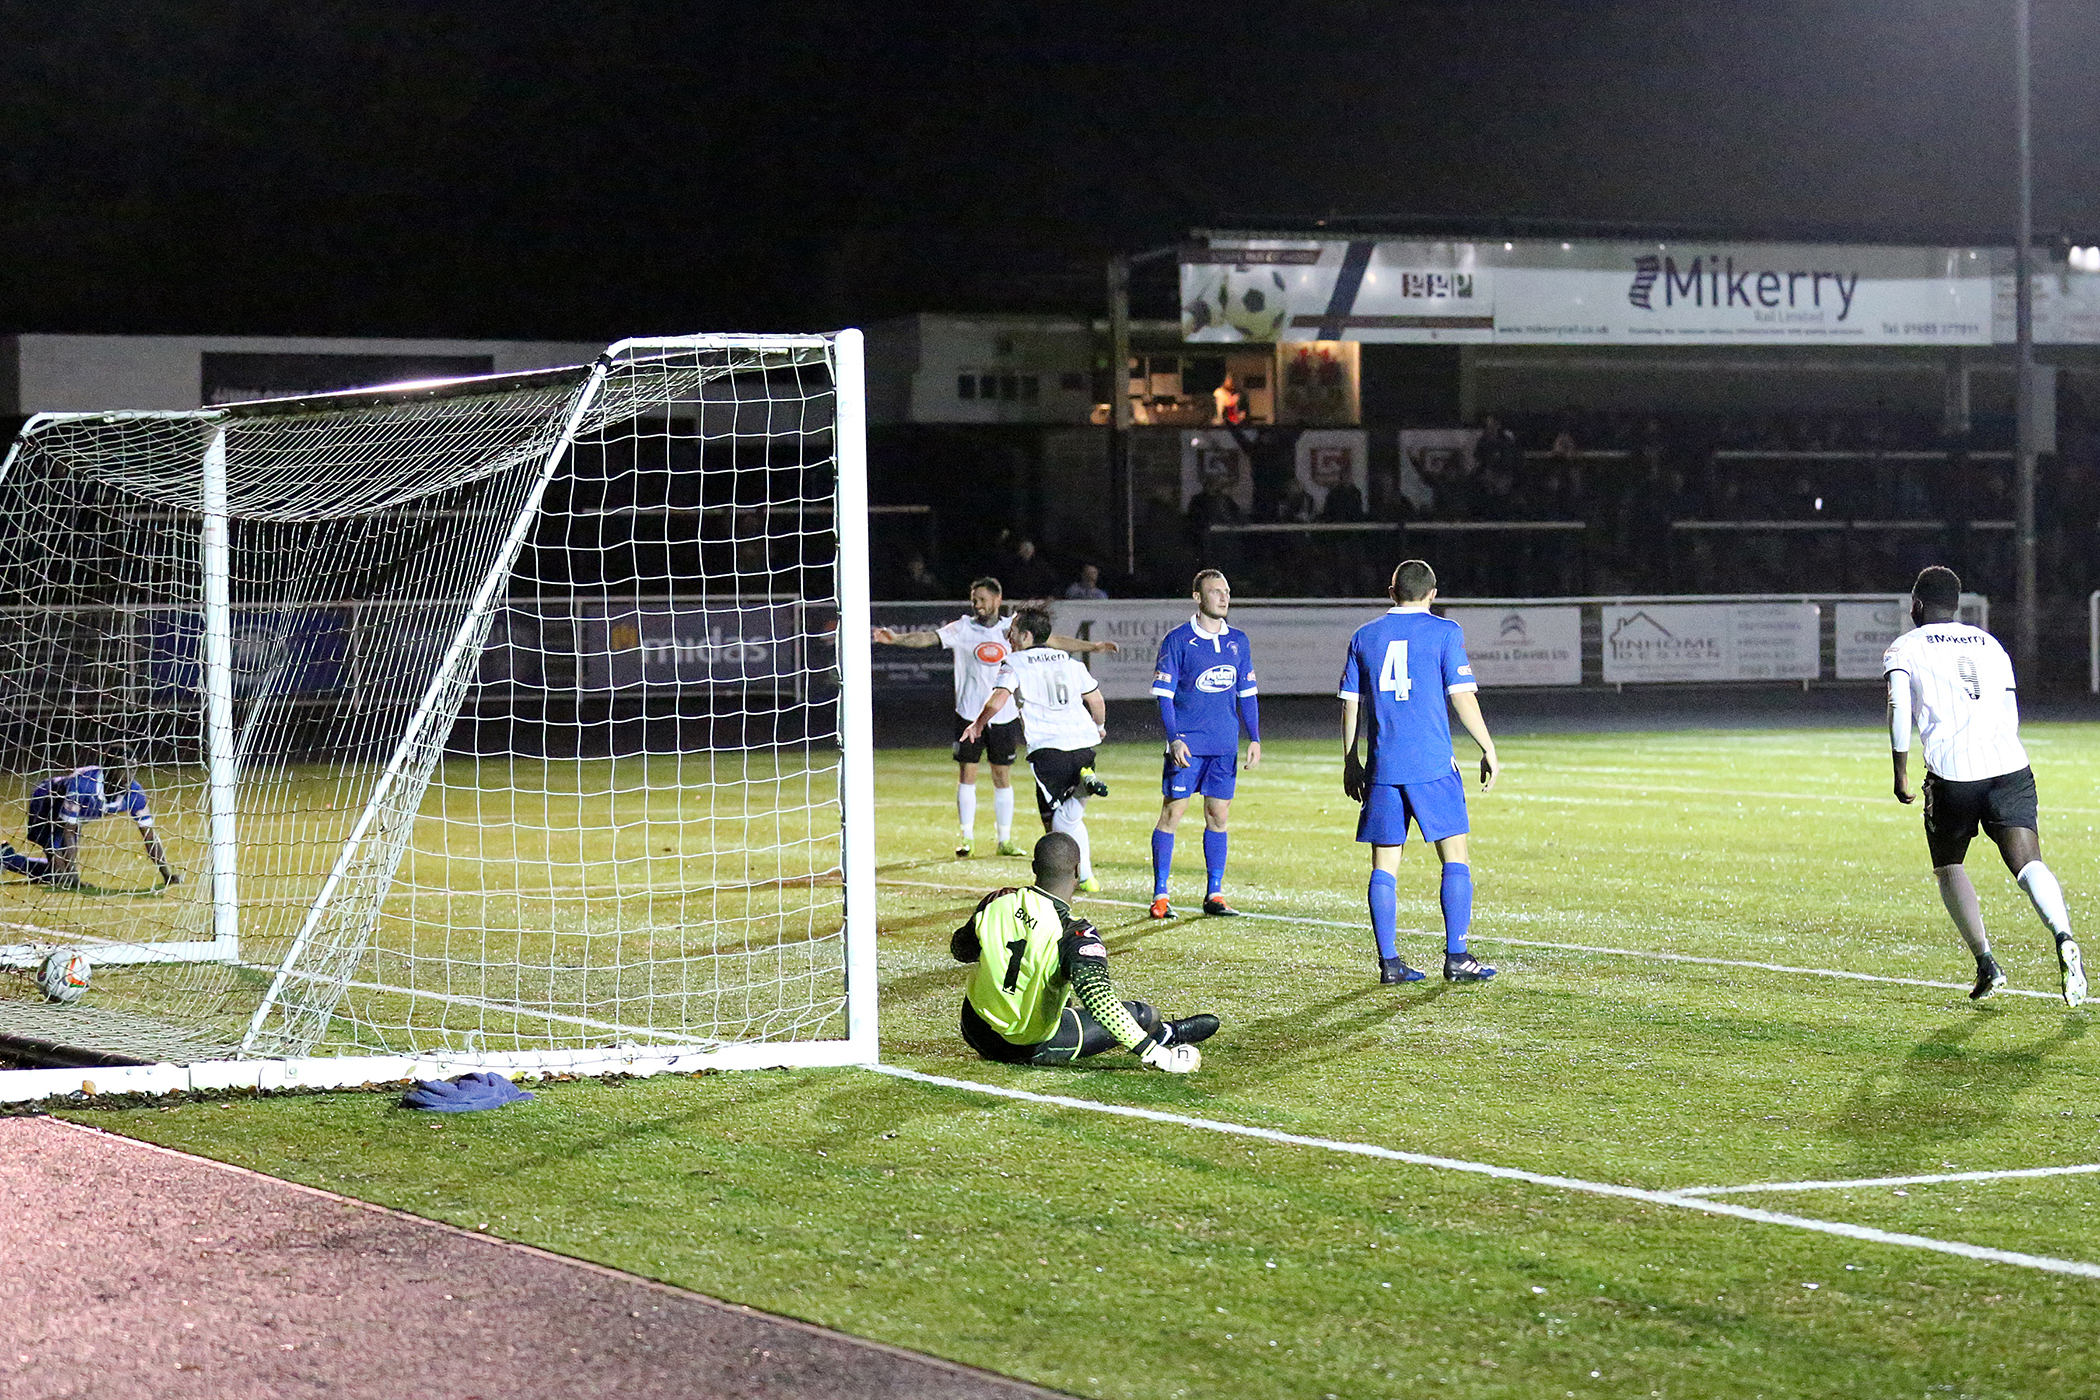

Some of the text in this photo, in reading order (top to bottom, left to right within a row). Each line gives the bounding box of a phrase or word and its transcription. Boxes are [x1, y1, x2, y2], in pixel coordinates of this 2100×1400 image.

[1665, 256, 1858, 321] Mikerry
[643, 627, 769, 664] midas
[1043, 670, 1069, 707] 16
[1379, 640, 1412, 701] 4
[1957, 656, 1981, 701] 9
[1014, 907, 1038, 930] BAXI
[1003, 938, 1028, 995] 1
